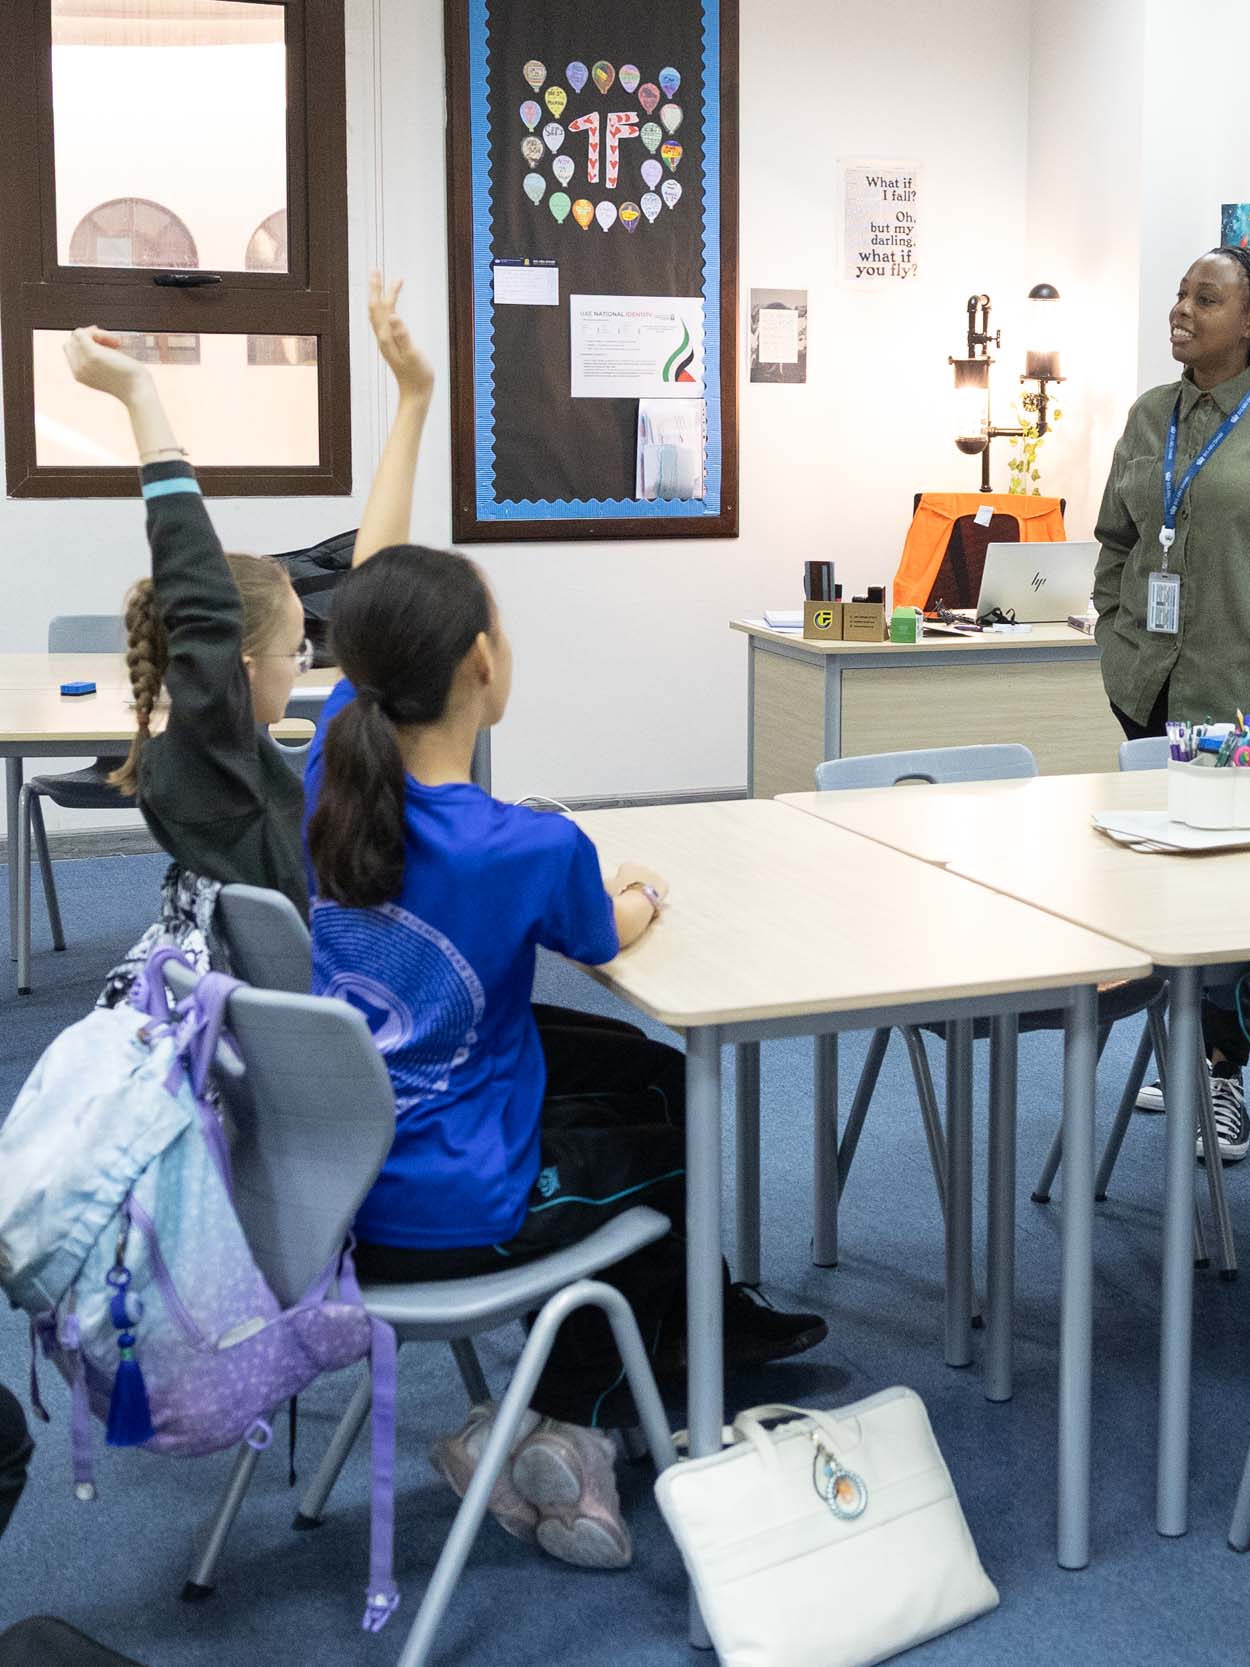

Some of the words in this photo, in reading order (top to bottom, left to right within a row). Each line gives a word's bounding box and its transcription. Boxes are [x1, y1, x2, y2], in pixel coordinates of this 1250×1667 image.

[865, 176, 899, 188] What
[903, 178, 913, 189] if
[883, 190, 887, 201] I
[892, 190, 917, 201] fall?
[871, 222, 890, 233] but
[894, 225, 914, 236] my
[859, 249, 896, 262] what
[901, 250, 912, 263] if
[856, 266, 885, 278] you
[890, 263, 918, 279] fly?
